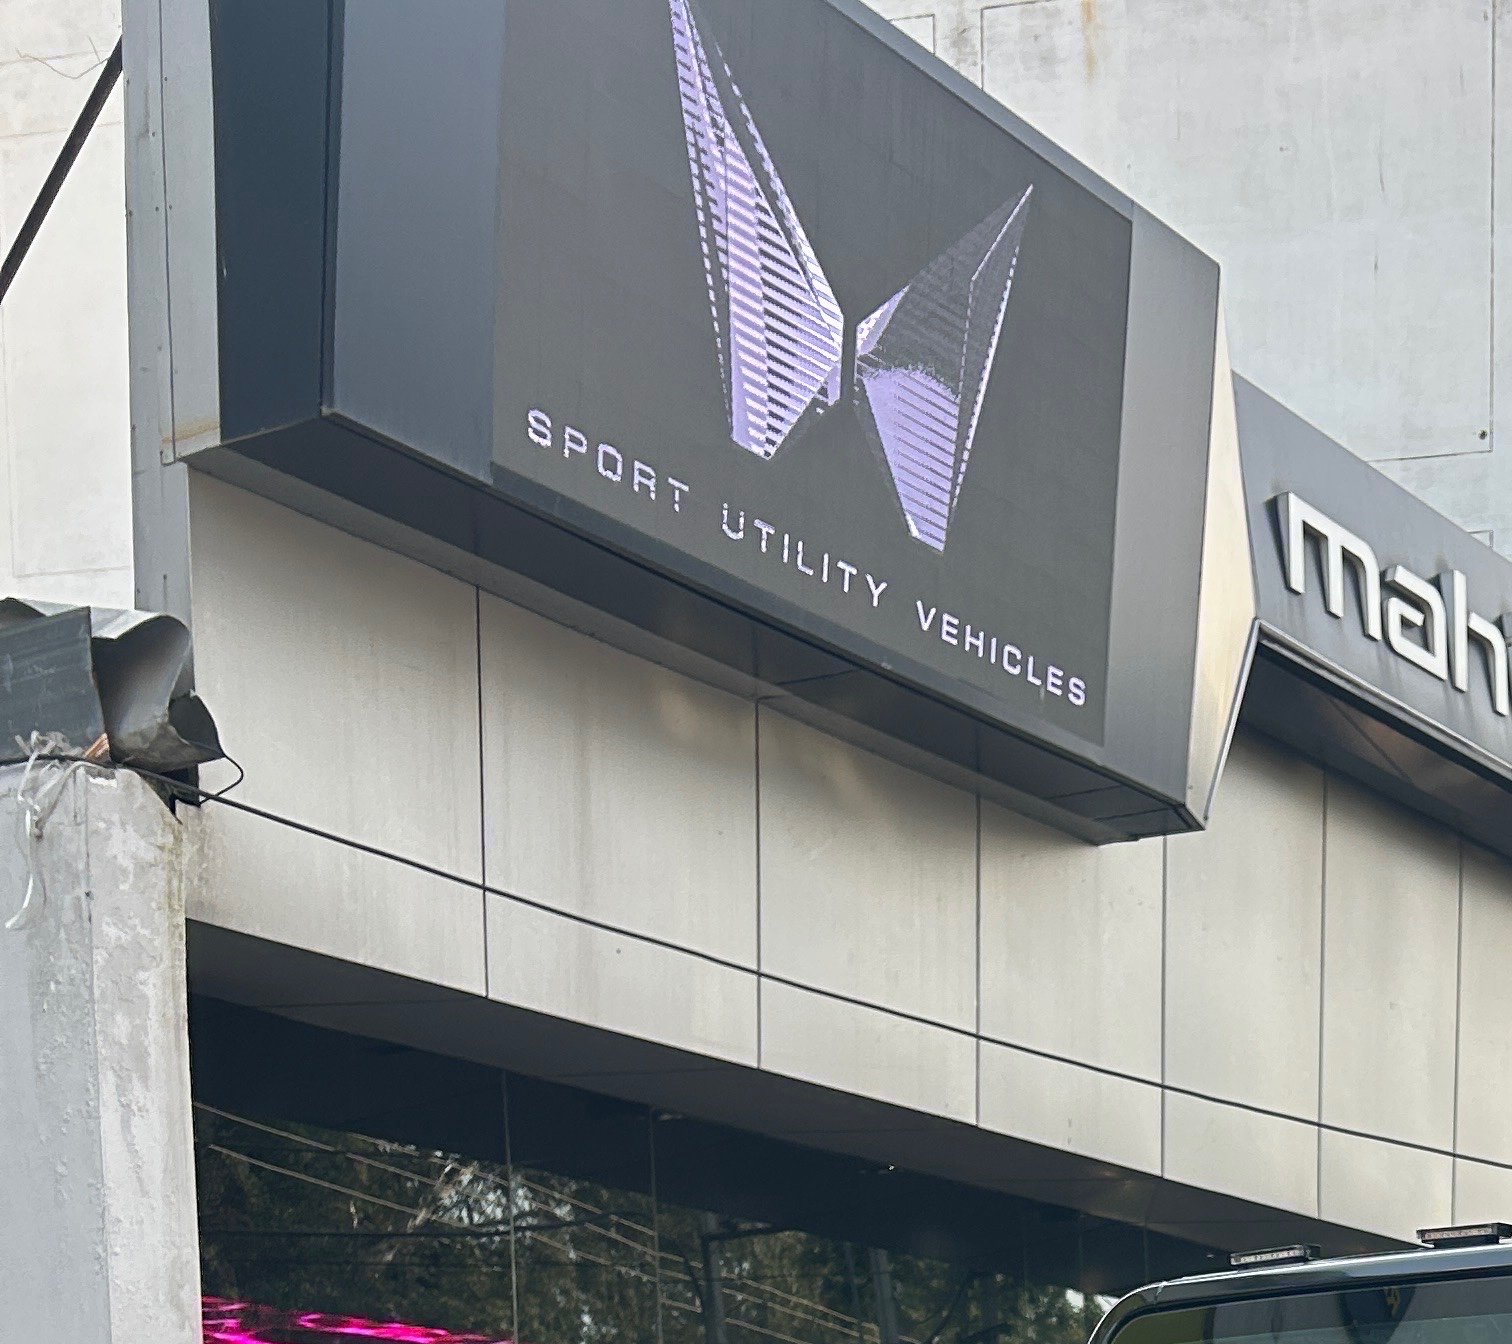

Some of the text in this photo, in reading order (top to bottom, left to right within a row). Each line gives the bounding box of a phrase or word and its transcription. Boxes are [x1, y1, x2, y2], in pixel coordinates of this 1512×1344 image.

[526, 408, 1087, 707] SPORT UTILITY VEHICLES
